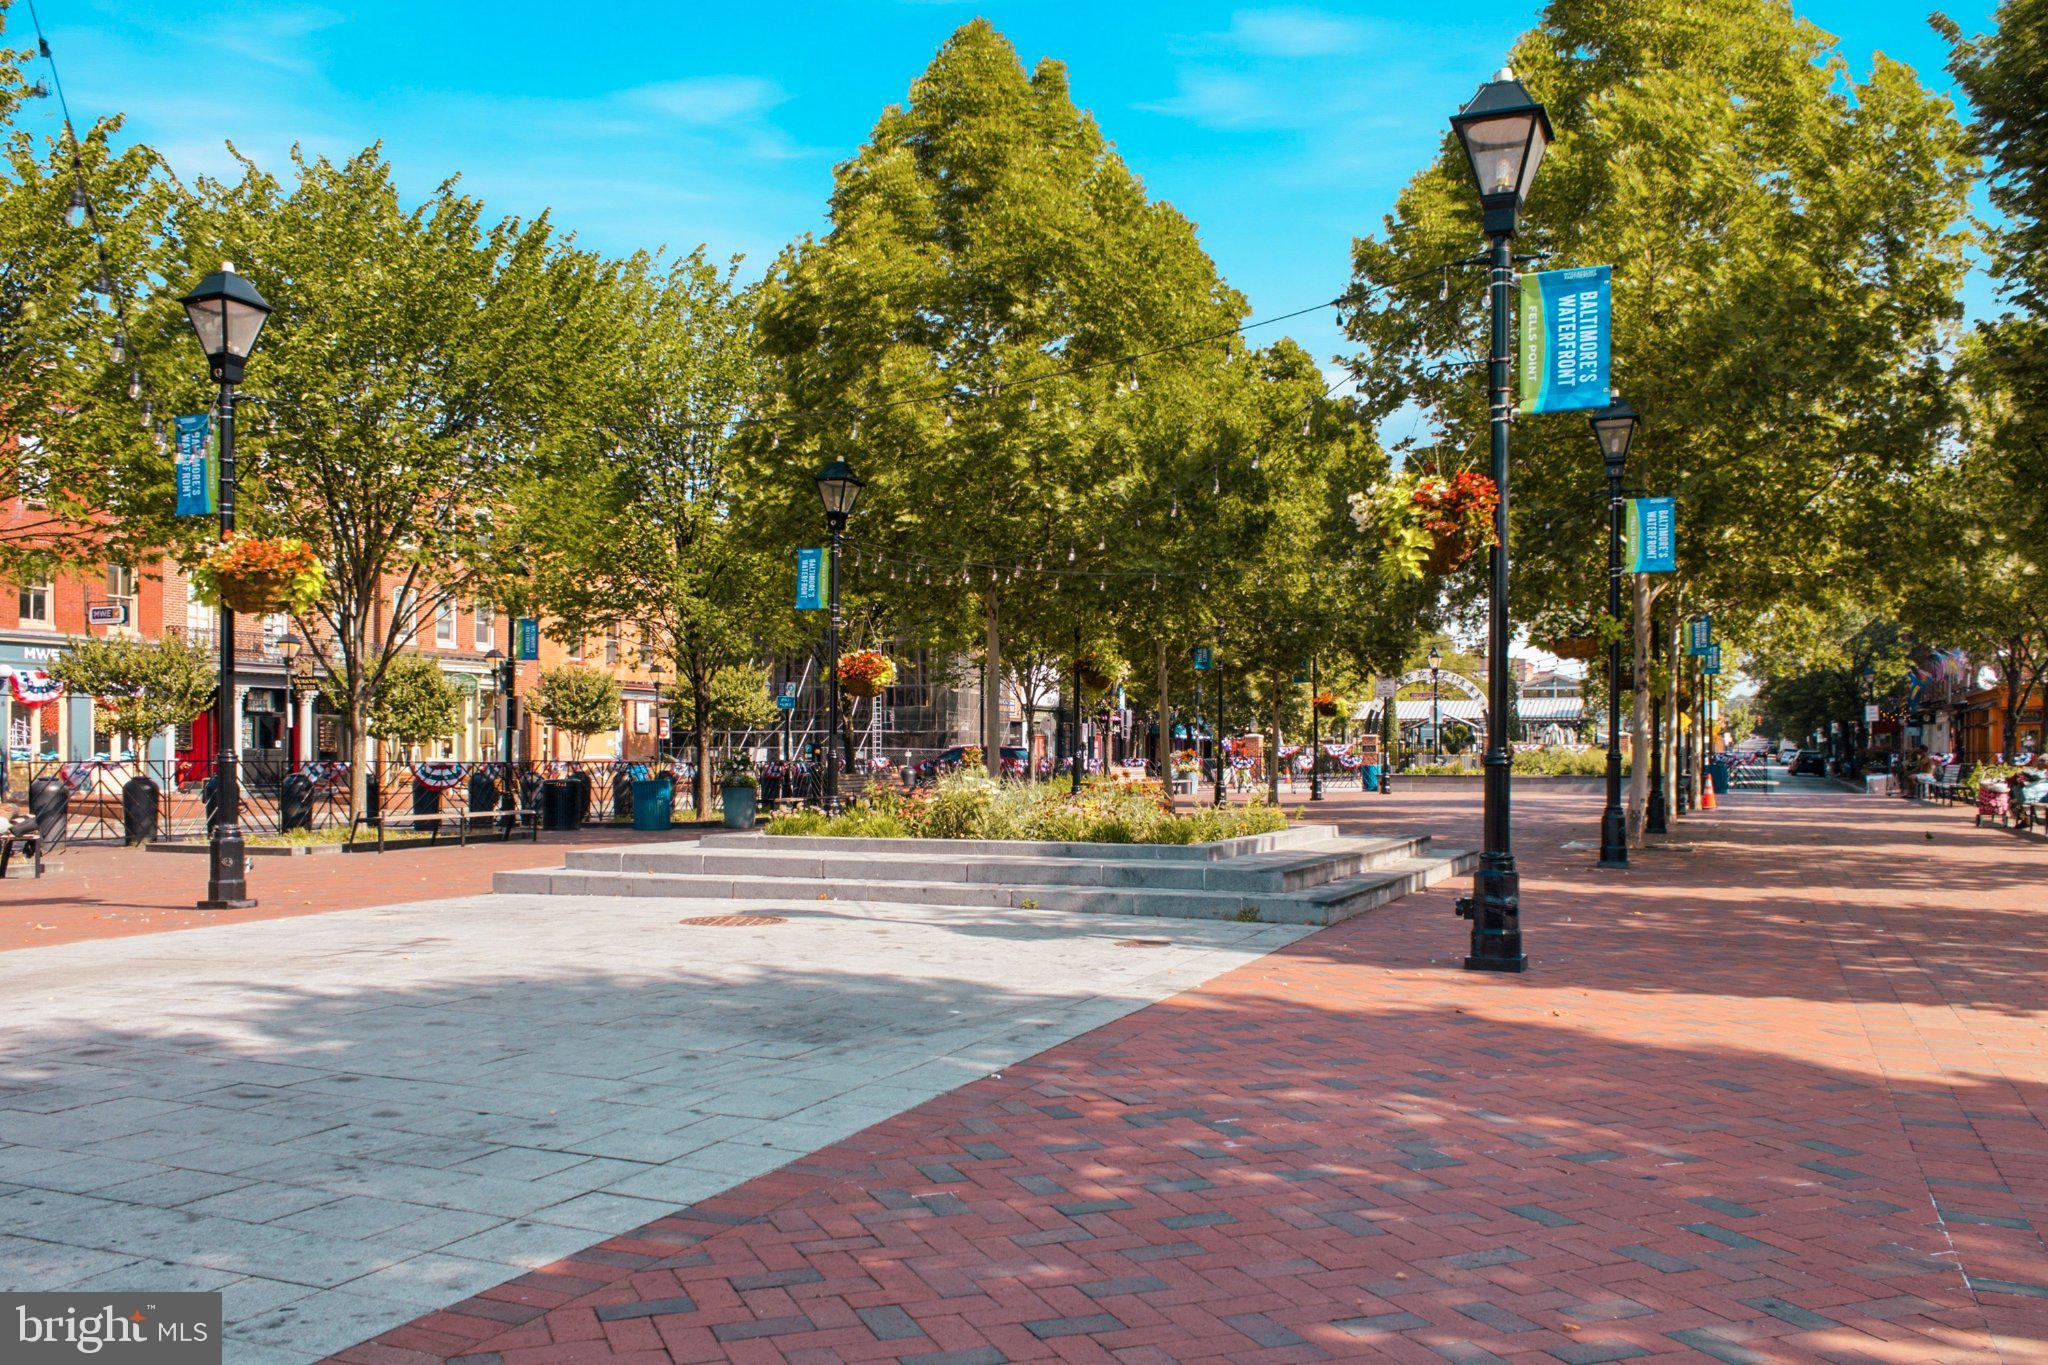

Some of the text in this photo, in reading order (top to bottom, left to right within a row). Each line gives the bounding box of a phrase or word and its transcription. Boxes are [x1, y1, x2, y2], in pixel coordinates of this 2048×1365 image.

[1528, 305, 1537, 382] FELLS POINT
[1558, 294, 1576, 386] WATERFRONT
[1579, 291, 1598, 383] BALTIMORE'S
[1646, 511, 1658, 560] WATERFRONT
[1658, 509, 1669, 559] BALTIMORE'S
[93, 609, 112, 618] MWE
[24, 647, 61, 660] MWE
